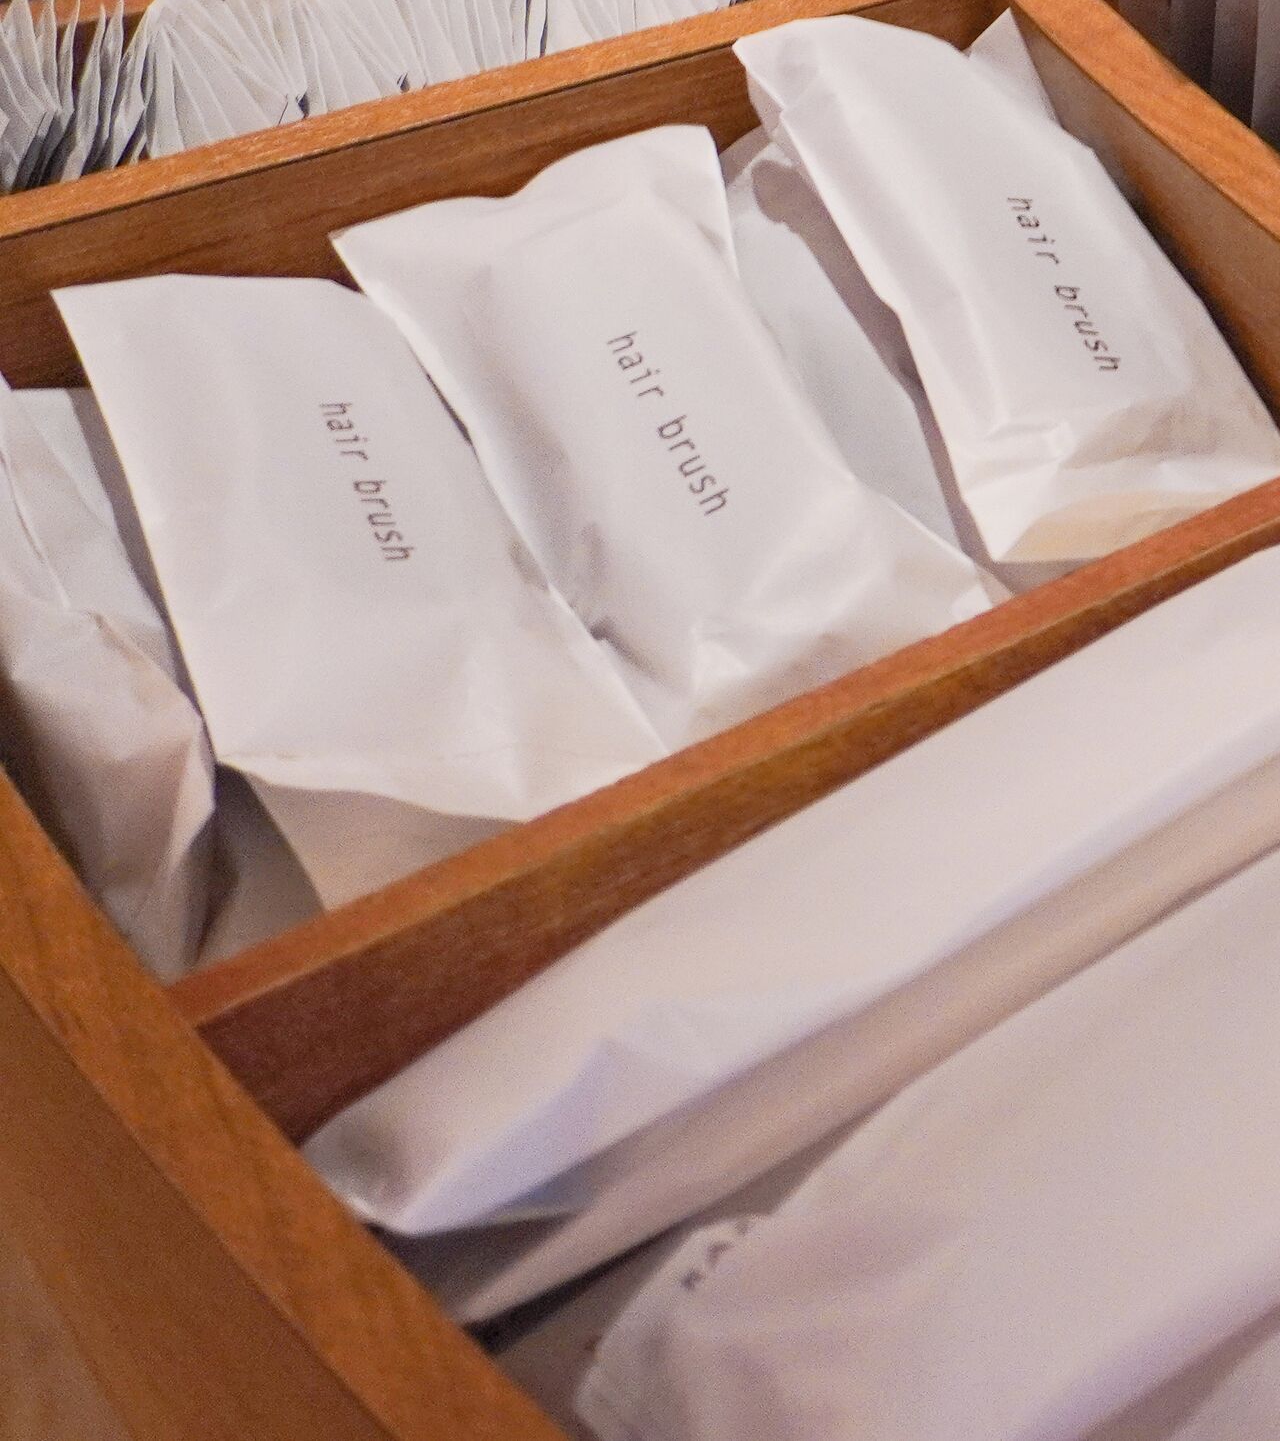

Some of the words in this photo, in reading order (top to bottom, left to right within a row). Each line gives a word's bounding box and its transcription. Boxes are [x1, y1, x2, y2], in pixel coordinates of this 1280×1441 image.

[1006, 197, 1060, 264] hair
[1053, 285, 1121, 371] brush
[318, 402, 369, 461] hair
[352, 479, 415, 561] brush
[606, 330, 664, 398] hair
[656, 414, 730, 517] brush
